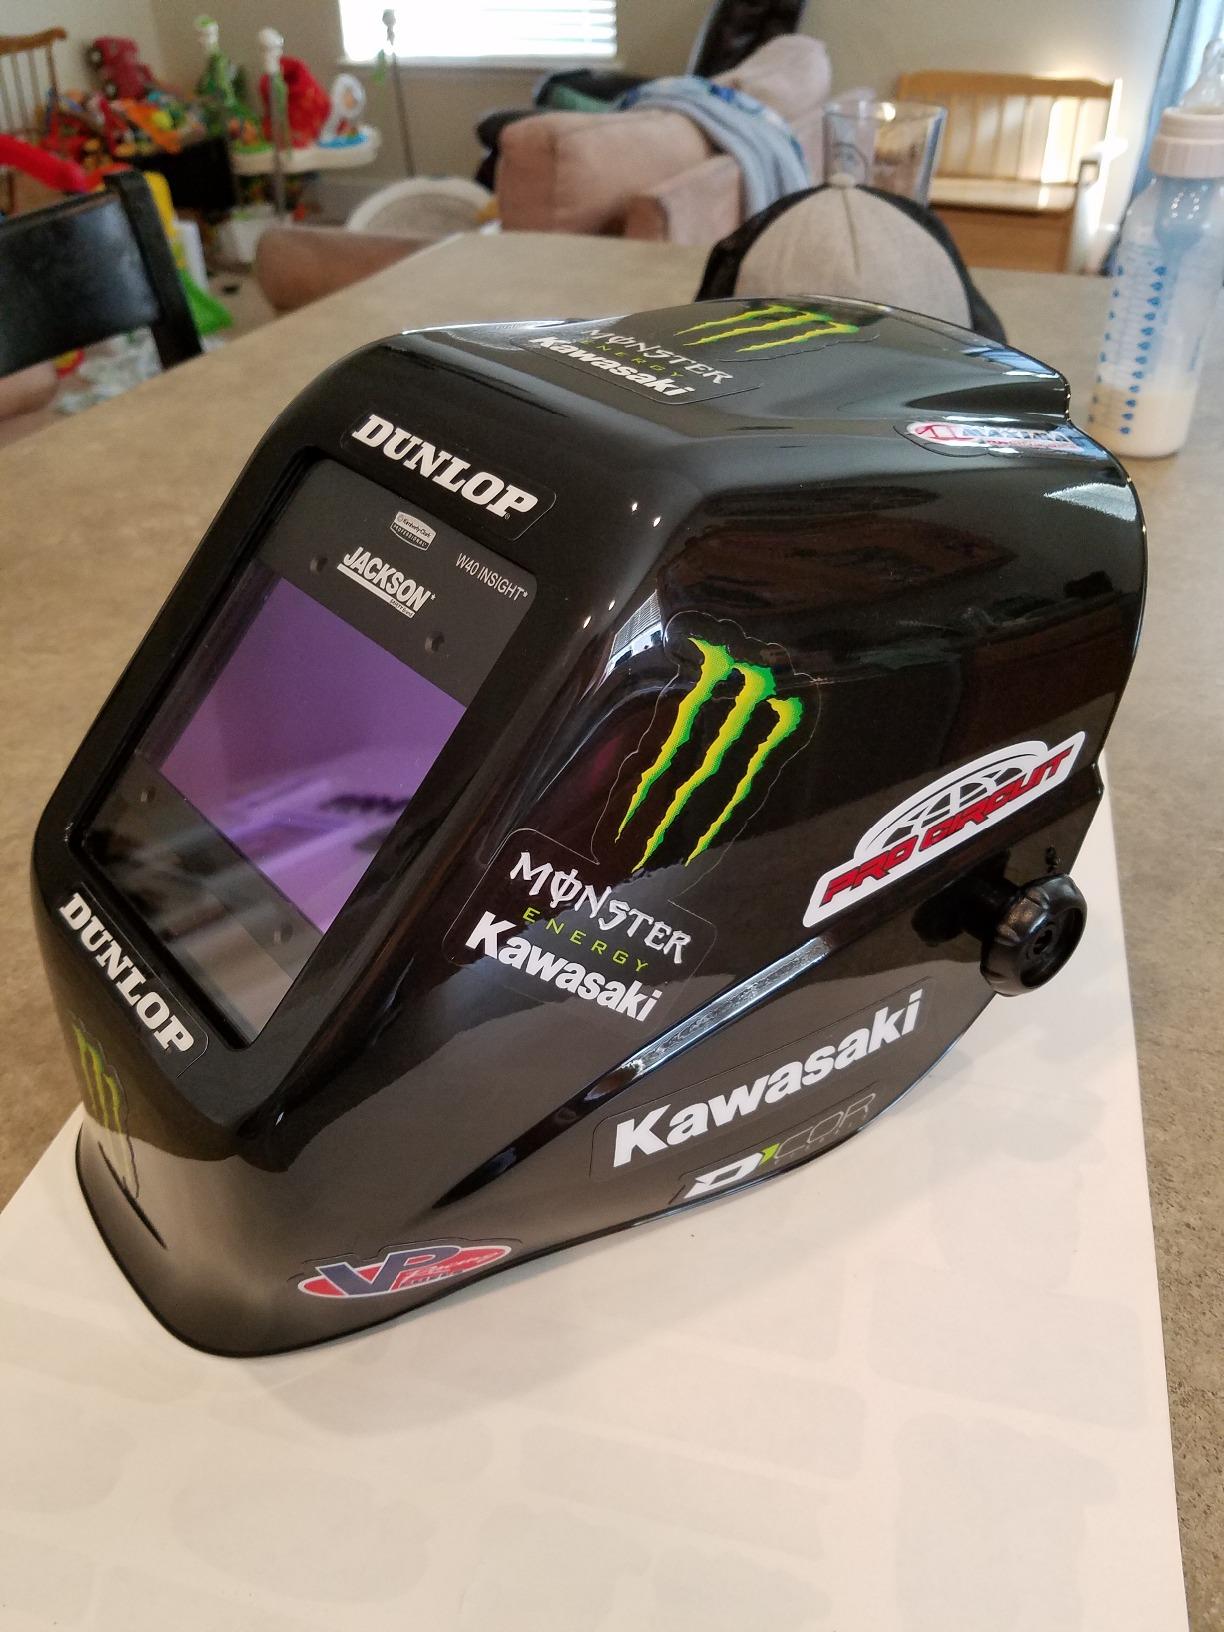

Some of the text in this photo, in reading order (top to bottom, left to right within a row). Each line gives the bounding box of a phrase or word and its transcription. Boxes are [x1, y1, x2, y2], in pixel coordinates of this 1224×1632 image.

[528, 336, 696, 397] Kawasaki
[579, 339, 684, 378] ENERGY
[351, 414, 539, 518] DUNLOP
[455, 552, 480, 577] W40
[819, 744, 1075, 908] PRO CIRCUIT
[59, 892, 195, 1052] DUNLOP
[465, 911, 663, 1022] Kawasaki
[522, 907, 649, 973] ENERGY
[613, 989, 923, 1168] Kawasaki
[315, 1245, 462, 1297] VP
